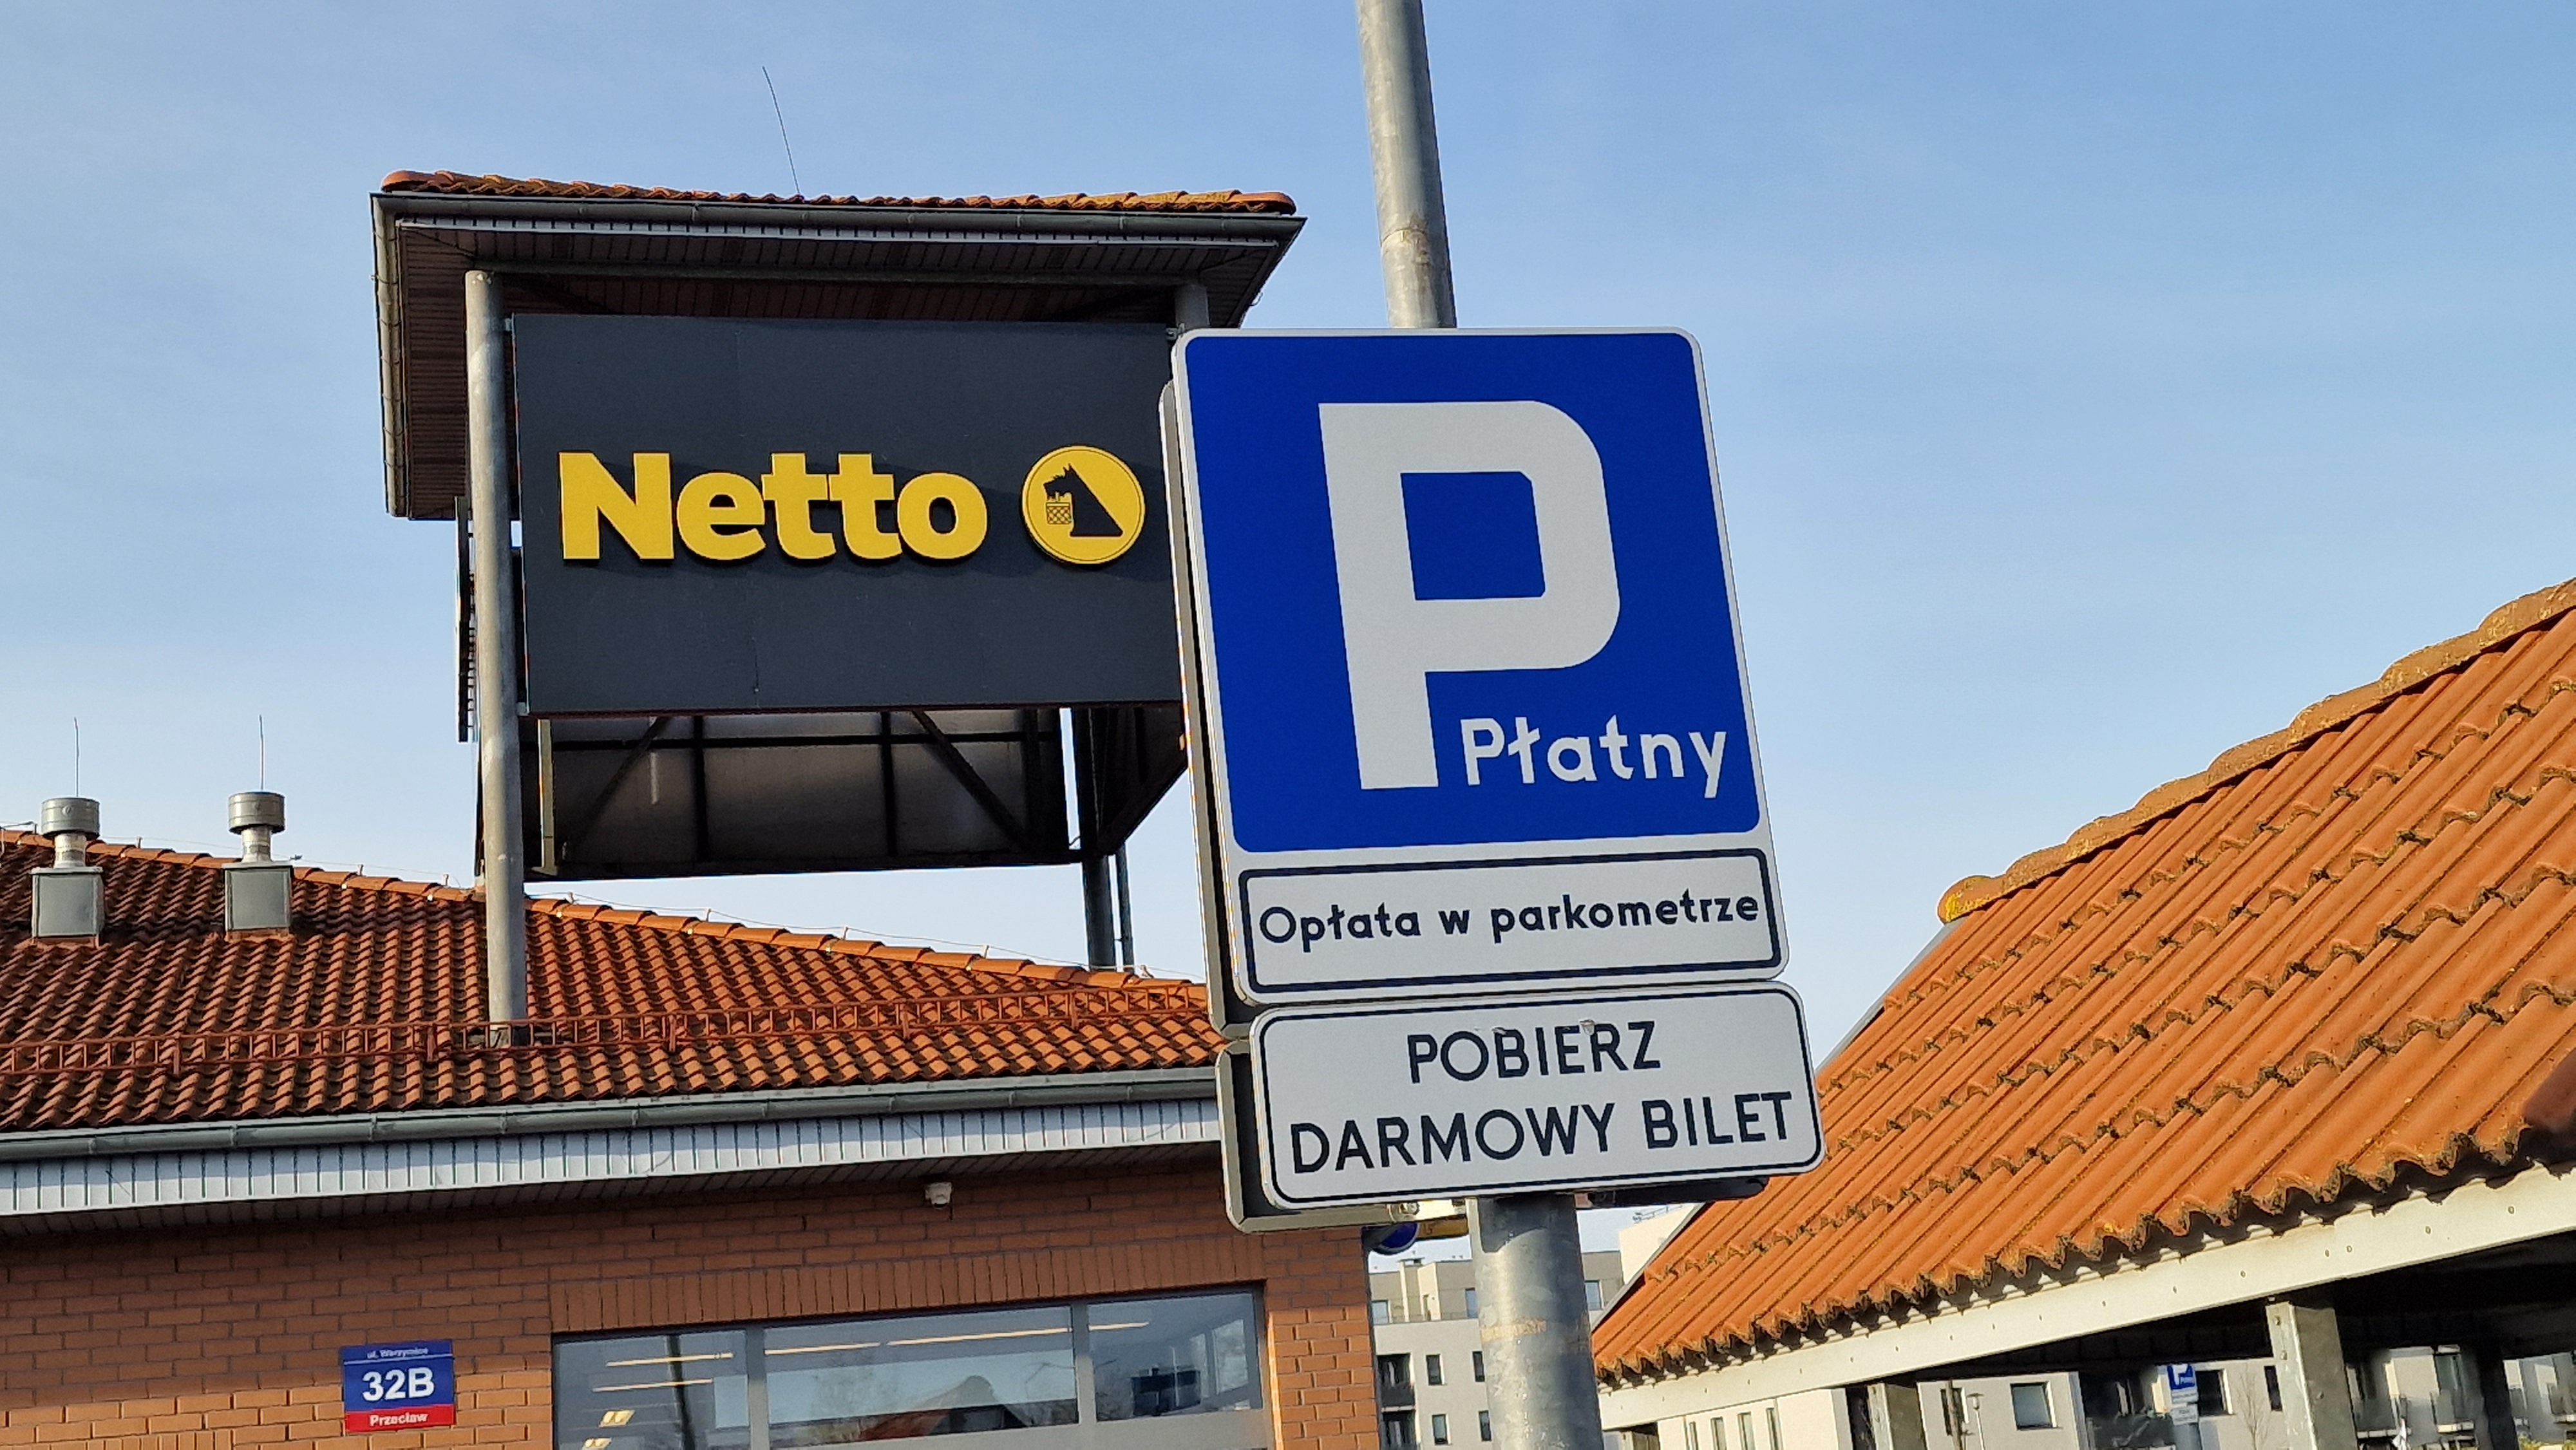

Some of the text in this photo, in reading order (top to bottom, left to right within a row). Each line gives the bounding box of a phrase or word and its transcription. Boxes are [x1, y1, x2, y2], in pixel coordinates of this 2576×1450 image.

[558, 452, 988, 560] Netto
[1318, 400, 1620, 790] P
[1461, 715, 1727, 799] Płatny
[1259, 889, 1759, 953] Opłata w parkometrze
[1407, 1021, 1662, 1084] POBIERZ
[1291, 1091, 1792, 1174] DARMOWY BILET
[362, 1366, 435, 1401] 32B
